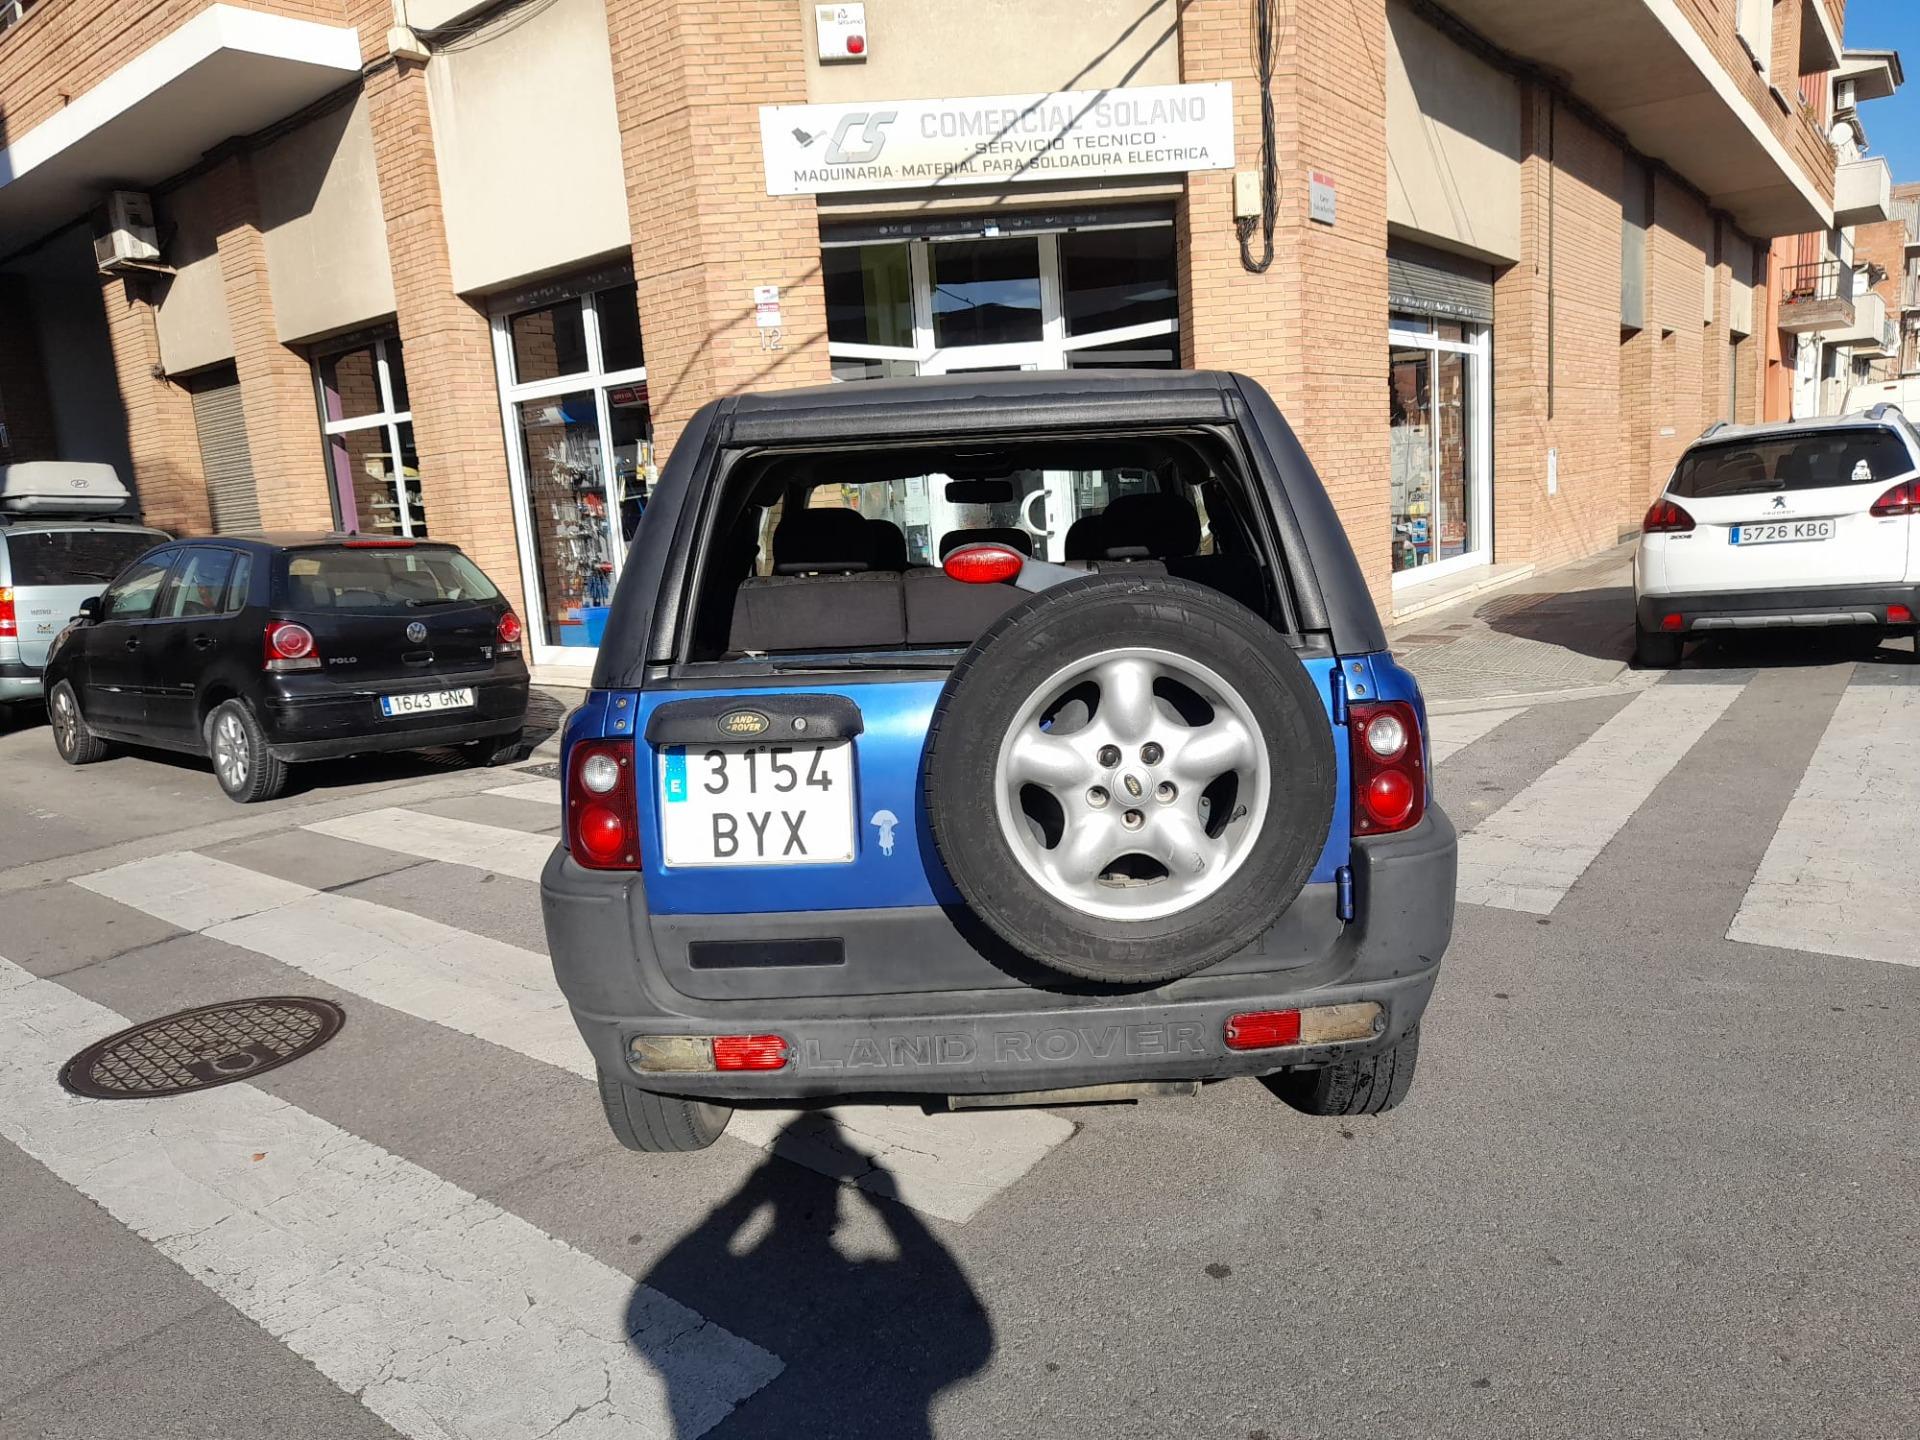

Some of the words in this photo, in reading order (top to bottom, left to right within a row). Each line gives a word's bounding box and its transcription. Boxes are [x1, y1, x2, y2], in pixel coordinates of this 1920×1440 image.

[920, 105, 1084, 139] COMERCIAL
[1094, 96, 1206, 129] SOLANO
[974, 137, 1065, 155] SERVICIO
[1073, 132, 1156, 149] TECNICO
[794, 166, 894, 183] MAQUINARIA
[902, 160, 977, 177] MATERIAL
[983, 156, 1025, 172] PARA
[1029, 152, 1123, 170] SOLDADURA
[1128, 146, 1209, 164] ELECTRICA
[760, 328, 783, 350] 12
[1743, 525, 1788, 541] 5726
[1794, 522, 1829, 538] KBG
[329, 656, 358, 665] POLO
[395, 695, 432, 711] 1643
[439, 689, 468, 707] GNK
[729, 715, 753, 724] LAND
[730, 723, 761, 732] ROVER
[703, 746, 833, 795] 3154
[671, 780, 682, 793] E
[712, 809, 808, 858] BYX
[805, 1033, 978, 1071] LAND
[995, 1020, 1206, 1065] ROVER
